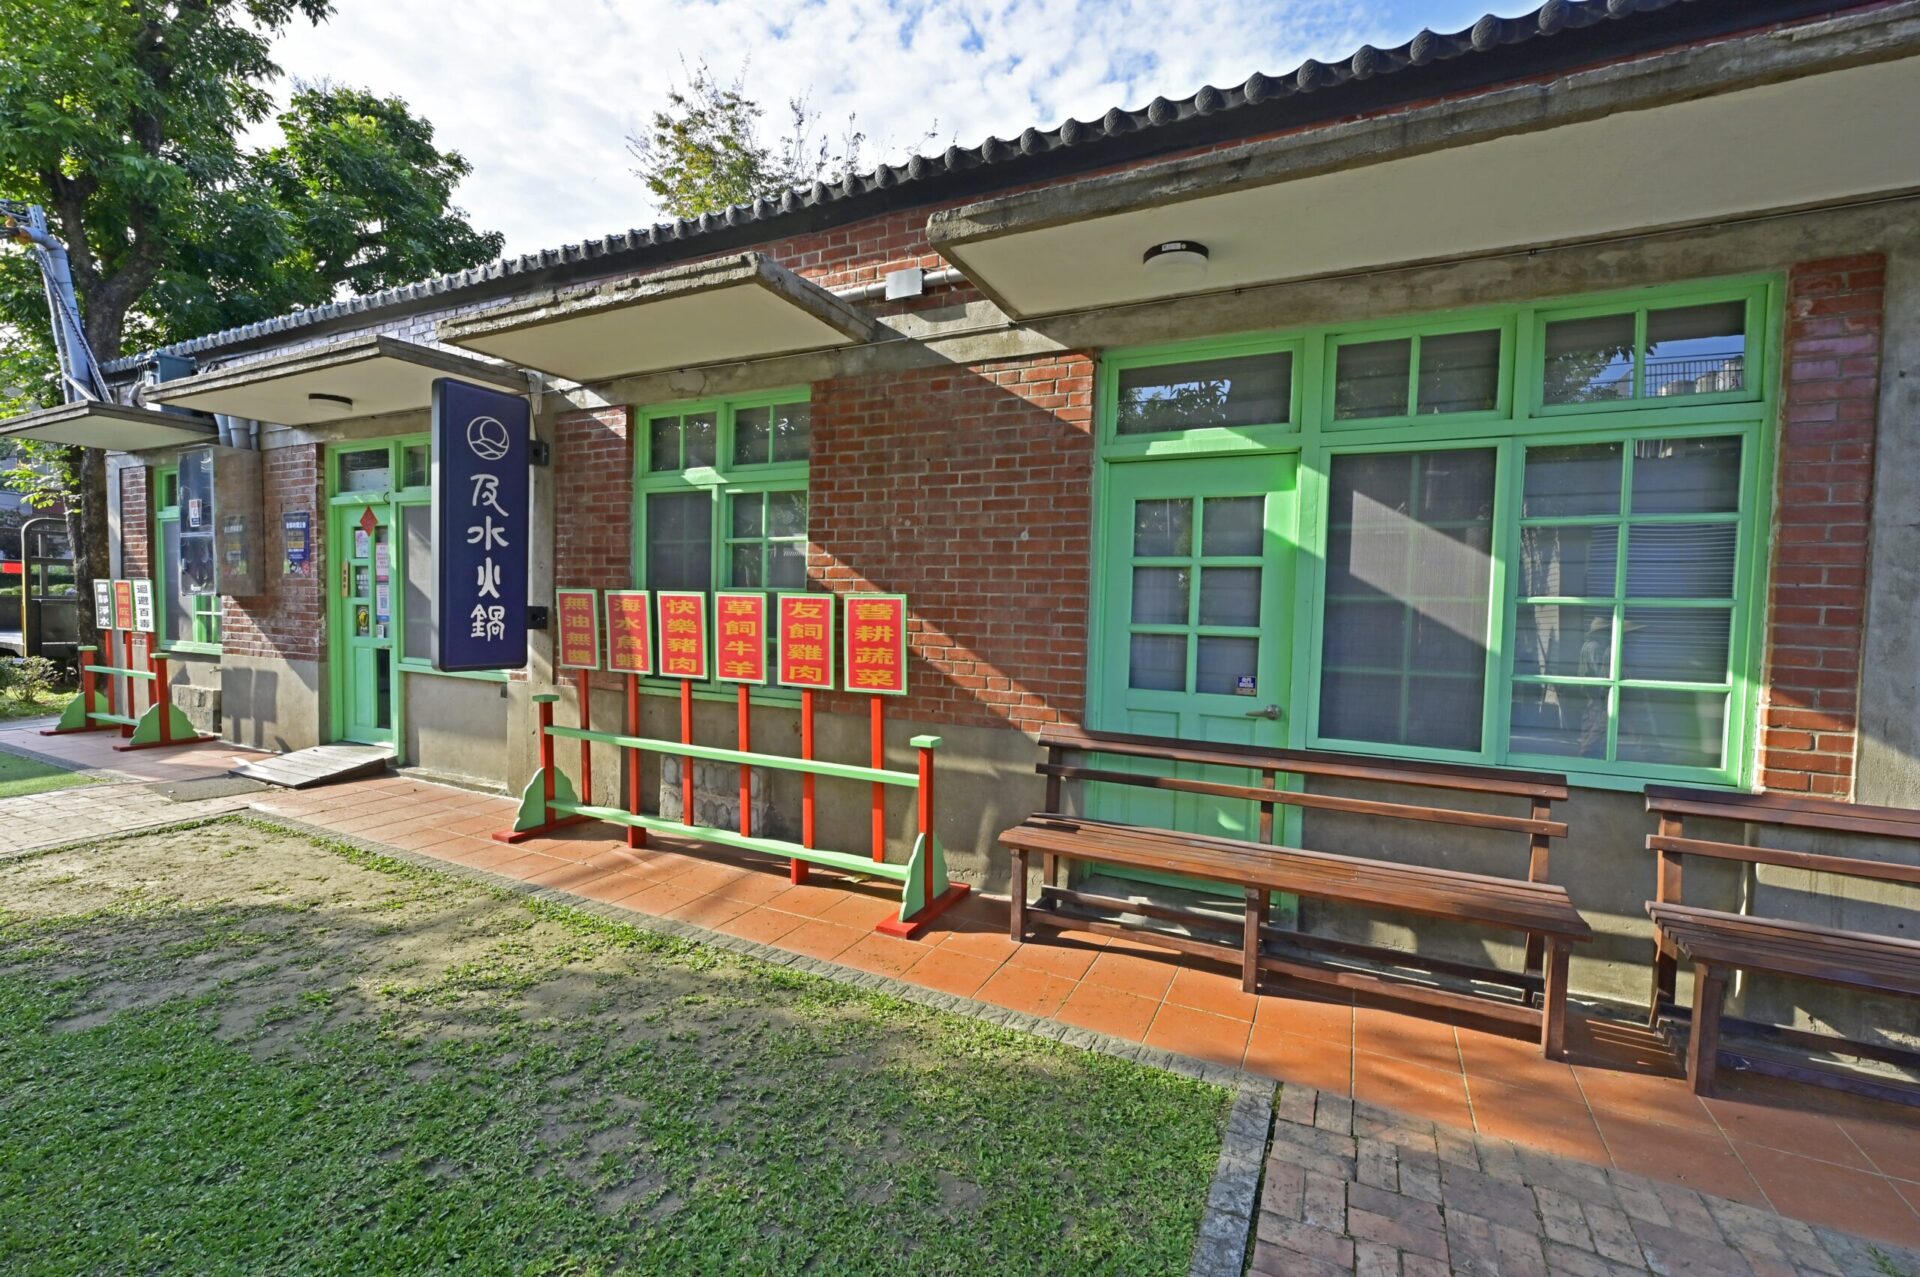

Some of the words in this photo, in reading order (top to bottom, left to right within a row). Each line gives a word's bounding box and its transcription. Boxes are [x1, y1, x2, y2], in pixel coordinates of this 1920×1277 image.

[466, 473, 510, 642] 及水火鍋
[614, 598, 644, 669] 海水魚蝦
[666, 599, 697, 673] 快樂豬肉
[723, 600, 757, 676] 草飼牛羊
[787, 601, 824, 682] 友飼雞肉
[855, 603, 895, 687] 善耕蔬菜
